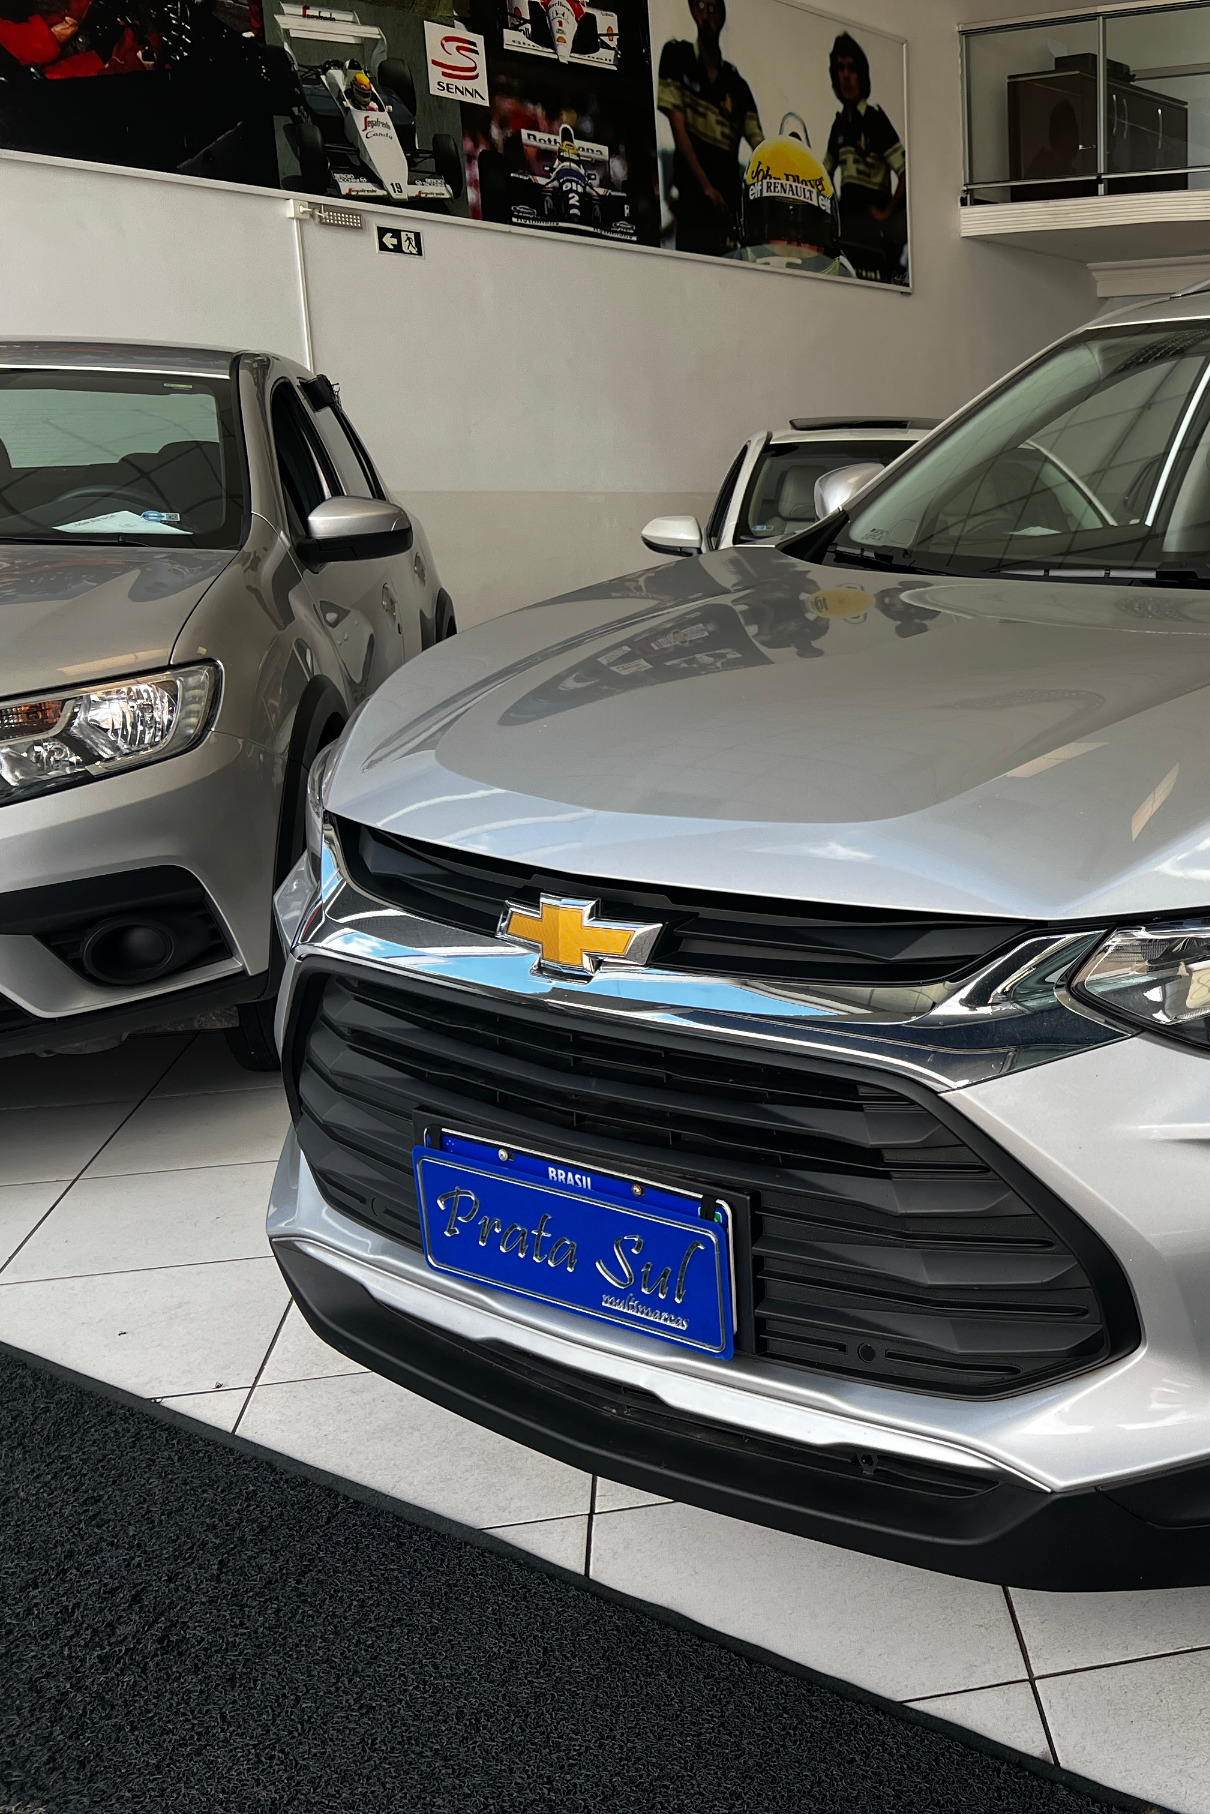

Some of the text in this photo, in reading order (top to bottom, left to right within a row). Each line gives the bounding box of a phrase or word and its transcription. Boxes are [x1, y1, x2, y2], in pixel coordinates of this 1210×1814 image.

[436, 81, 486, 101] SENNA
[526, 132, 603, 156] Rothans
[390, 182, 404, 194] 19
[765, 181, 814, 202] RENAULT
[568, 192, 580, 206] 2
[436, 1186, 706, 1304] Prata Sul
[602, 1293, 690, 1331] multimarcas
